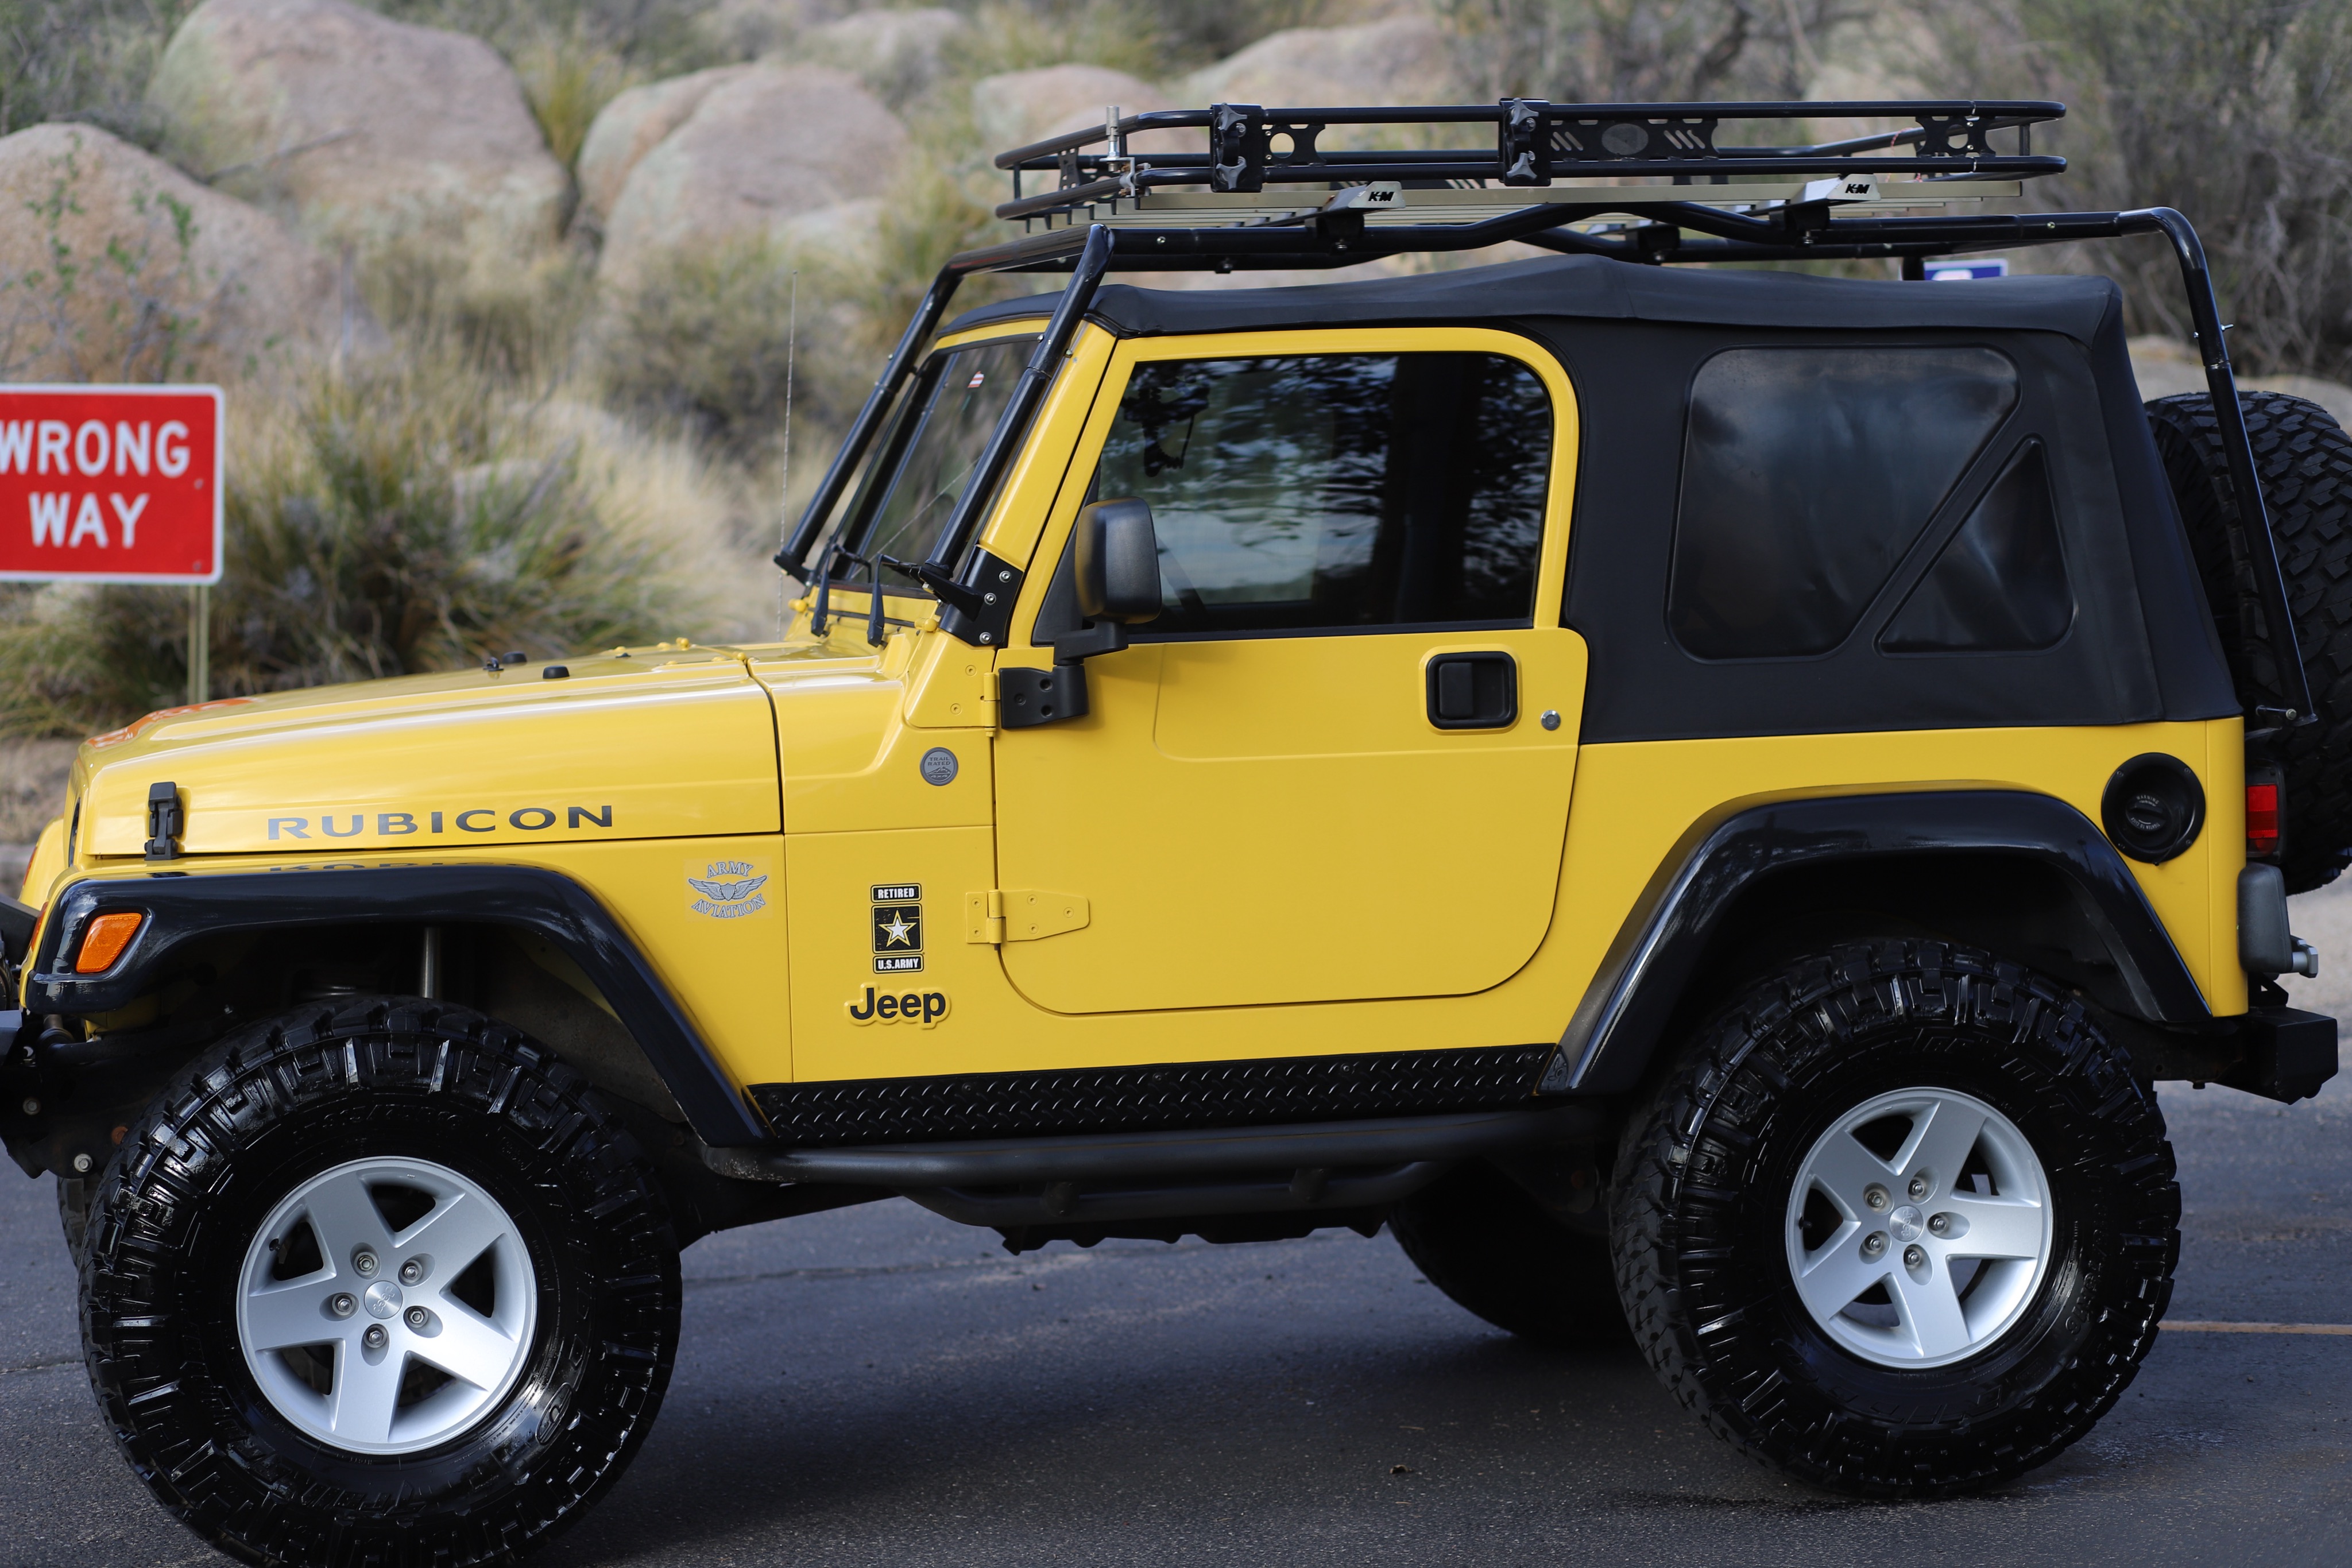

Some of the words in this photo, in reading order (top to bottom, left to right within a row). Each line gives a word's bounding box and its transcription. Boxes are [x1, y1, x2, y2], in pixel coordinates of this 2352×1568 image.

[0, 419, 191, 479] WRONG
[28, 490, 151, 549] WAY
[2136, 795, 2159, 804] WARNING
[268, 805, 613, 840] RUBICON
[707, 861, 753, 878] ARMY
[691, 893, 766, 918] AVIATION
[877, 888, 915, 899] RETIRED
[850, 987, 946, 1023] Jeep
